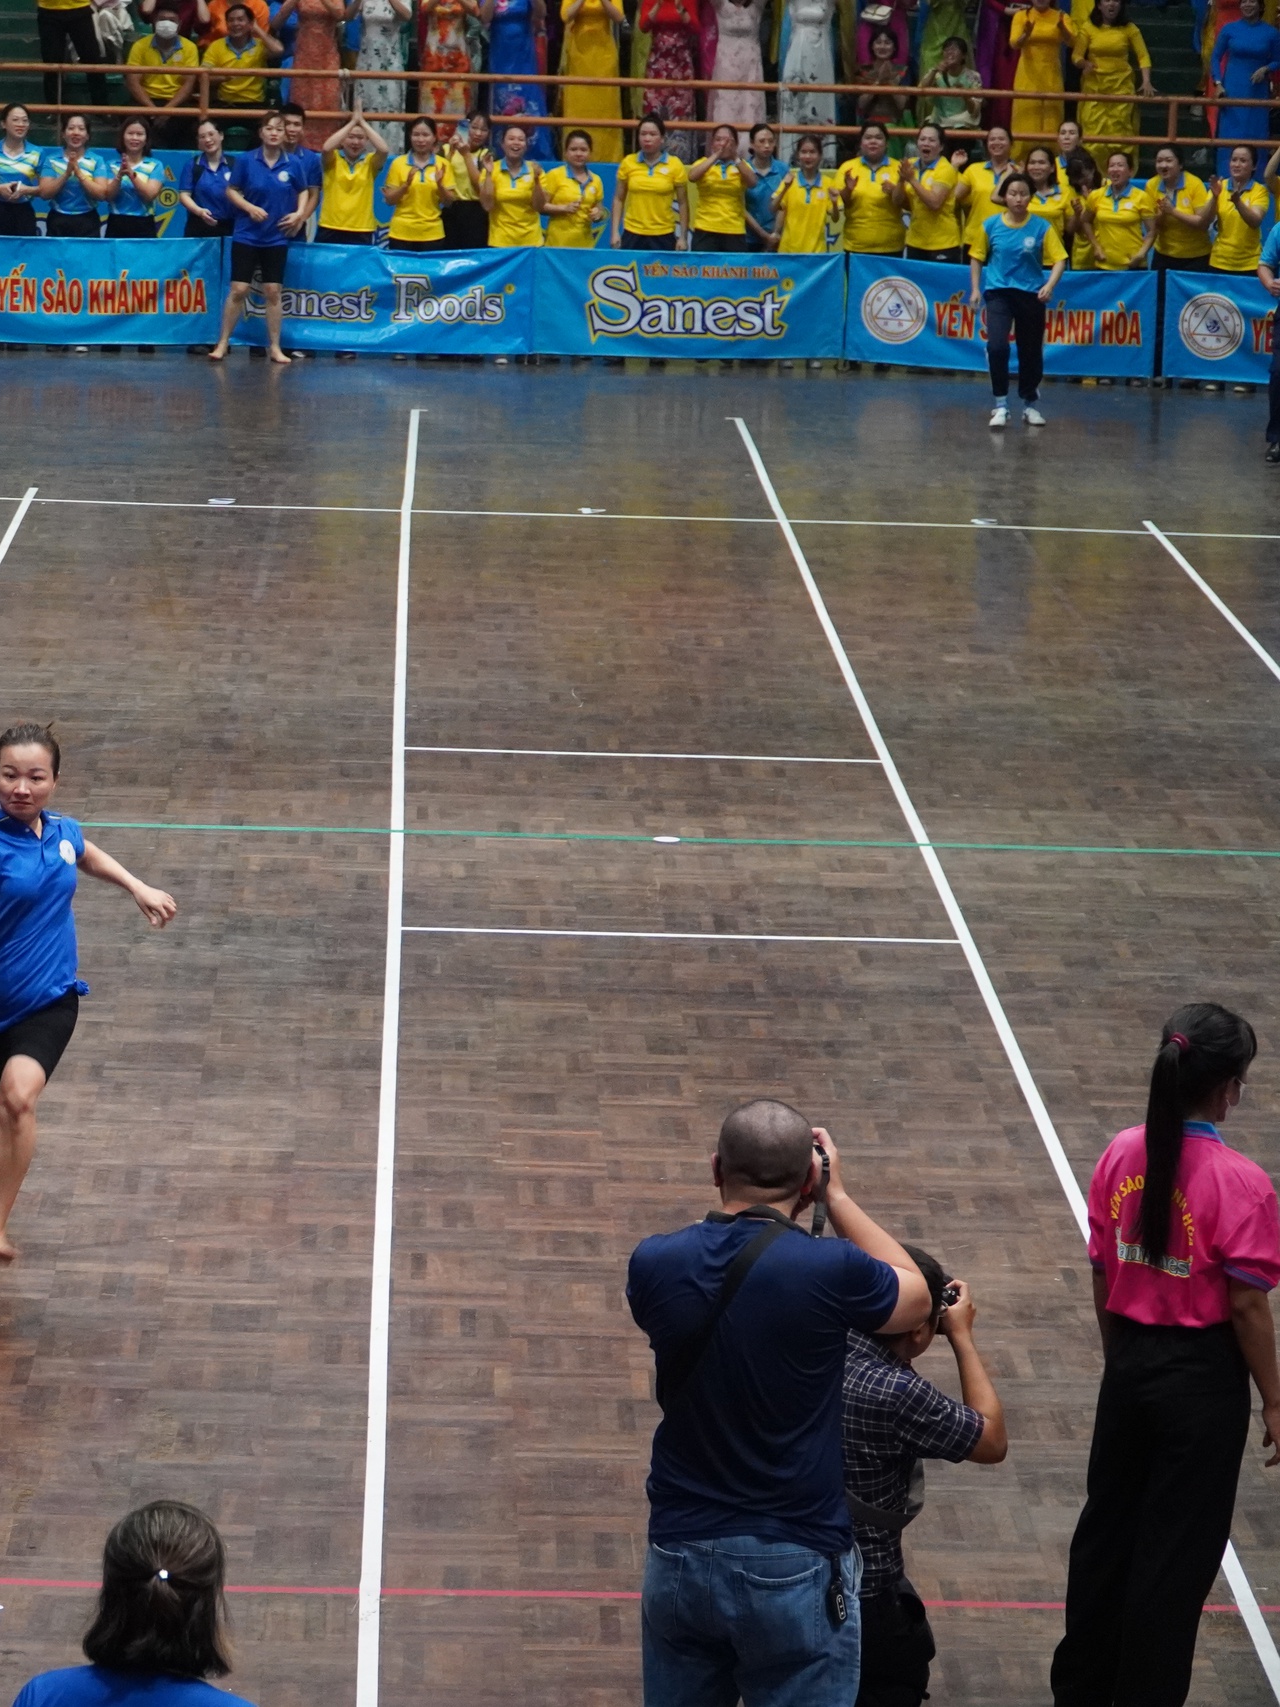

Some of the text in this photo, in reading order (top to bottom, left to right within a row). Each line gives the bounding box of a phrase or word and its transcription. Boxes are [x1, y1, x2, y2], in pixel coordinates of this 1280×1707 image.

[42, 268, 83, 315] SÀO
[87, 269, 159, 315] KHÁNH
[164, 270, 207, 314] HÒA
[643, 260, 779, 280] YẾN SÀO KHÁNH HÒA
[391, 273, 505, 325] Foods
[586, 261, 792, 344] Sanest
[934, 291, 975, 341] YẾN
[1042, 300, 1096, 346] HÁNH
[1100, 299, 1143, 347] HÒA
